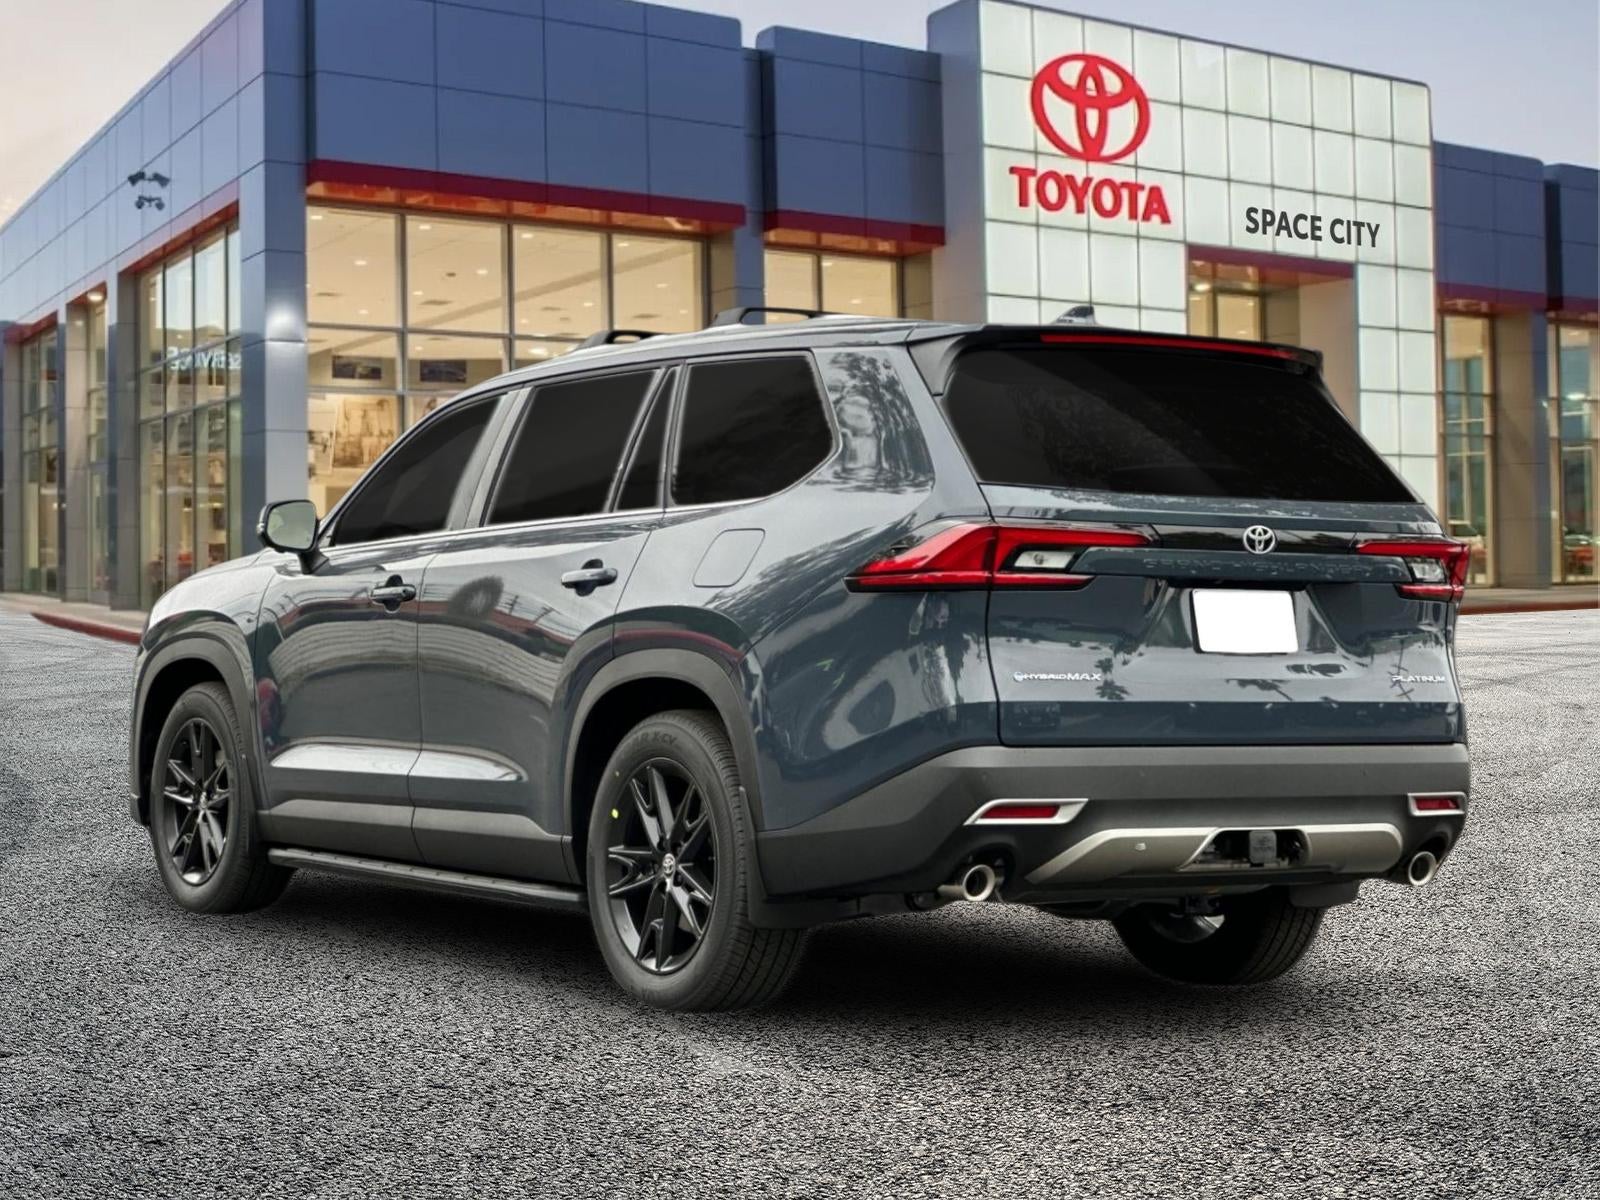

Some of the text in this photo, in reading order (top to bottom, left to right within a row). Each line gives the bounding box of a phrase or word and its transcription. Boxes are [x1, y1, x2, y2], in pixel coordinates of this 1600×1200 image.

[1009, 166, 1171, 225] TOYOTA
[1245, 206, 1381, 248] SPACE CITY
